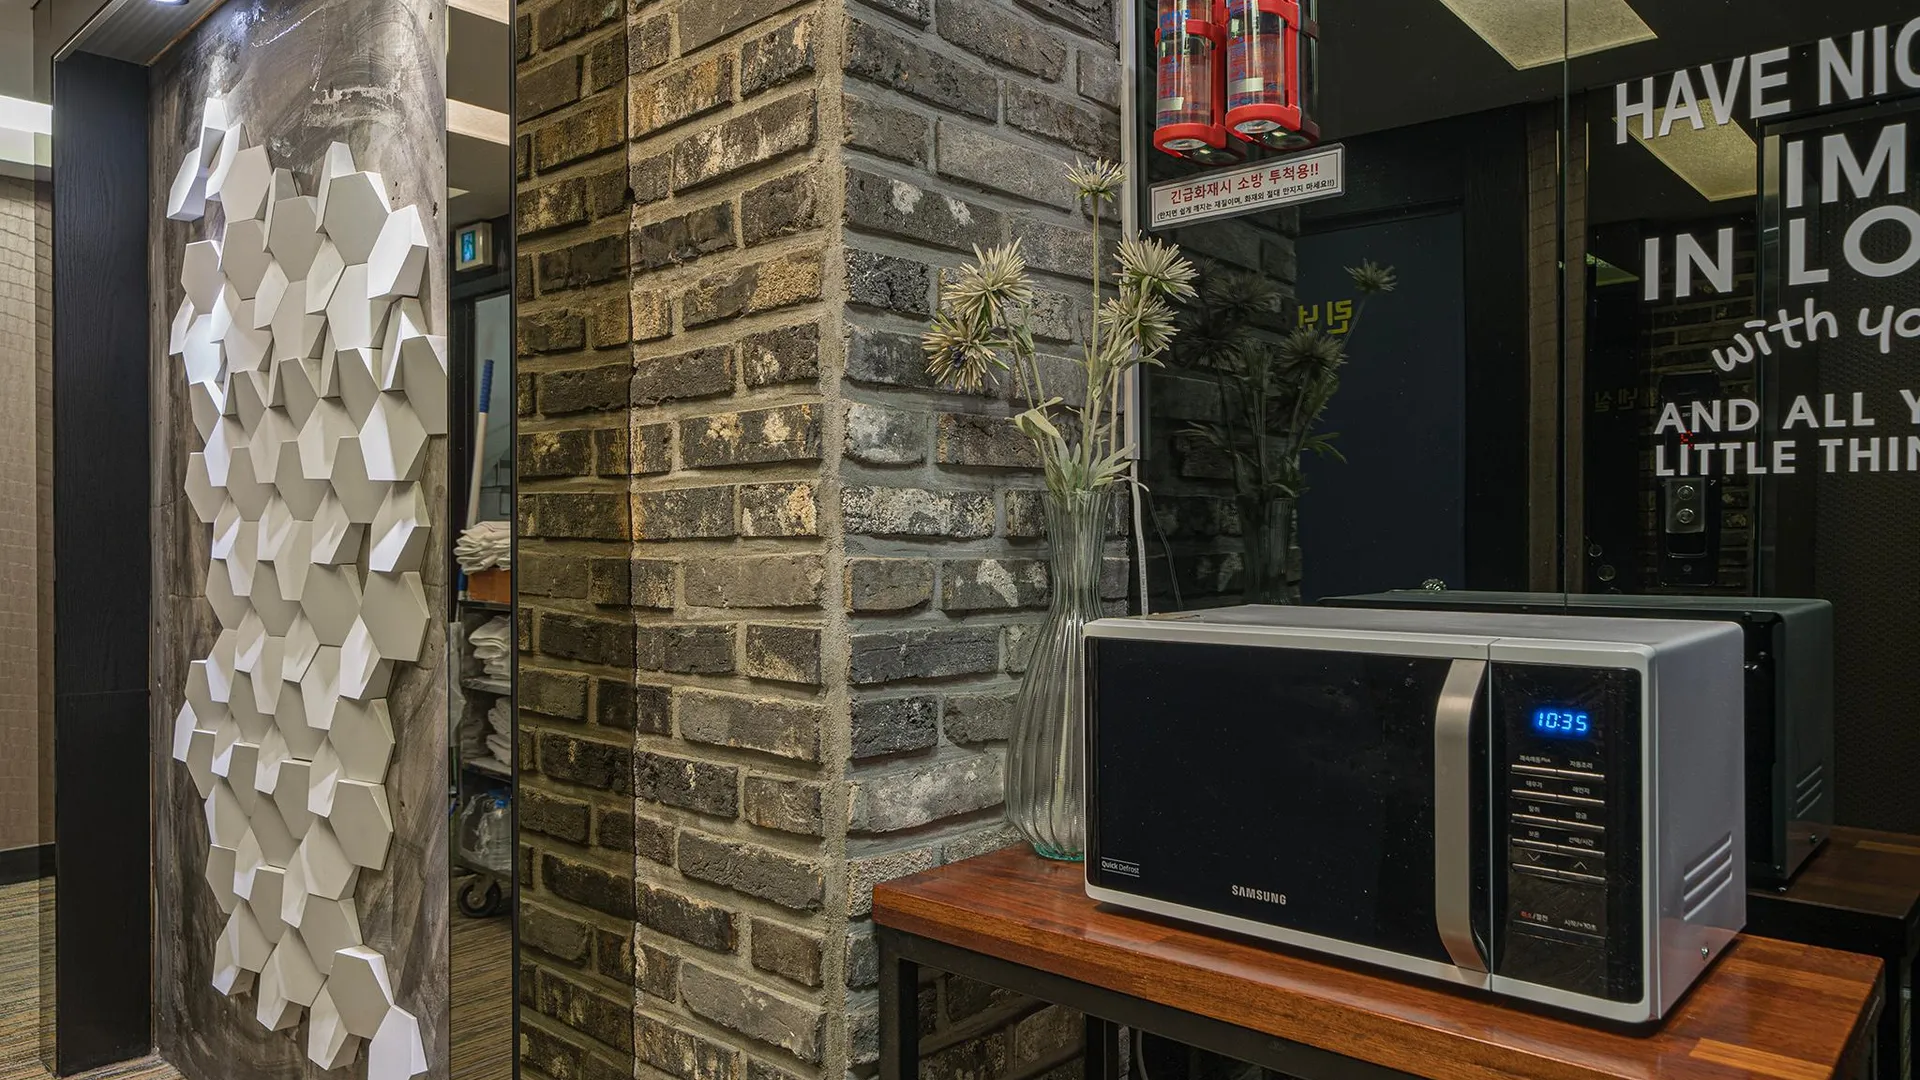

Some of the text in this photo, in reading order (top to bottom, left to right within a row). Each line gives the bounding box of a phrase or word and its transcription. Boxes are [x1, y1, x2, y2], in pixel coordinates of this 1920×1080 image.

[1615, 46, 1791, 145] HAVE
[1171, 163, 1318, 204] 긴급화재시 소방 투척용!!
[1786, 123, 1907, 208] IM
[1157, 208, 1178, 220] (만지면
[1179, 205, 1192, 216] 쉽게
[1267, 189, 1280, 198] 절대
[1283, 185, 1303, 195] 만지지
[1306, 179, 1334, 192] 마세요!!)
[1643, 227, 1734, 301] IN
[1711, 298, 1838, 372] with
[1654, 398, 1760, 434] AND
[1782, 392, 1875, 430] ALL
[1655, 441, 1797, 476] LITTLE
[1537, 712, 1587, 731] 10:35
[1102, 860, 1139, 874] Quick Defrost
[1232, 885, 1287, 905] SAMSUNG
